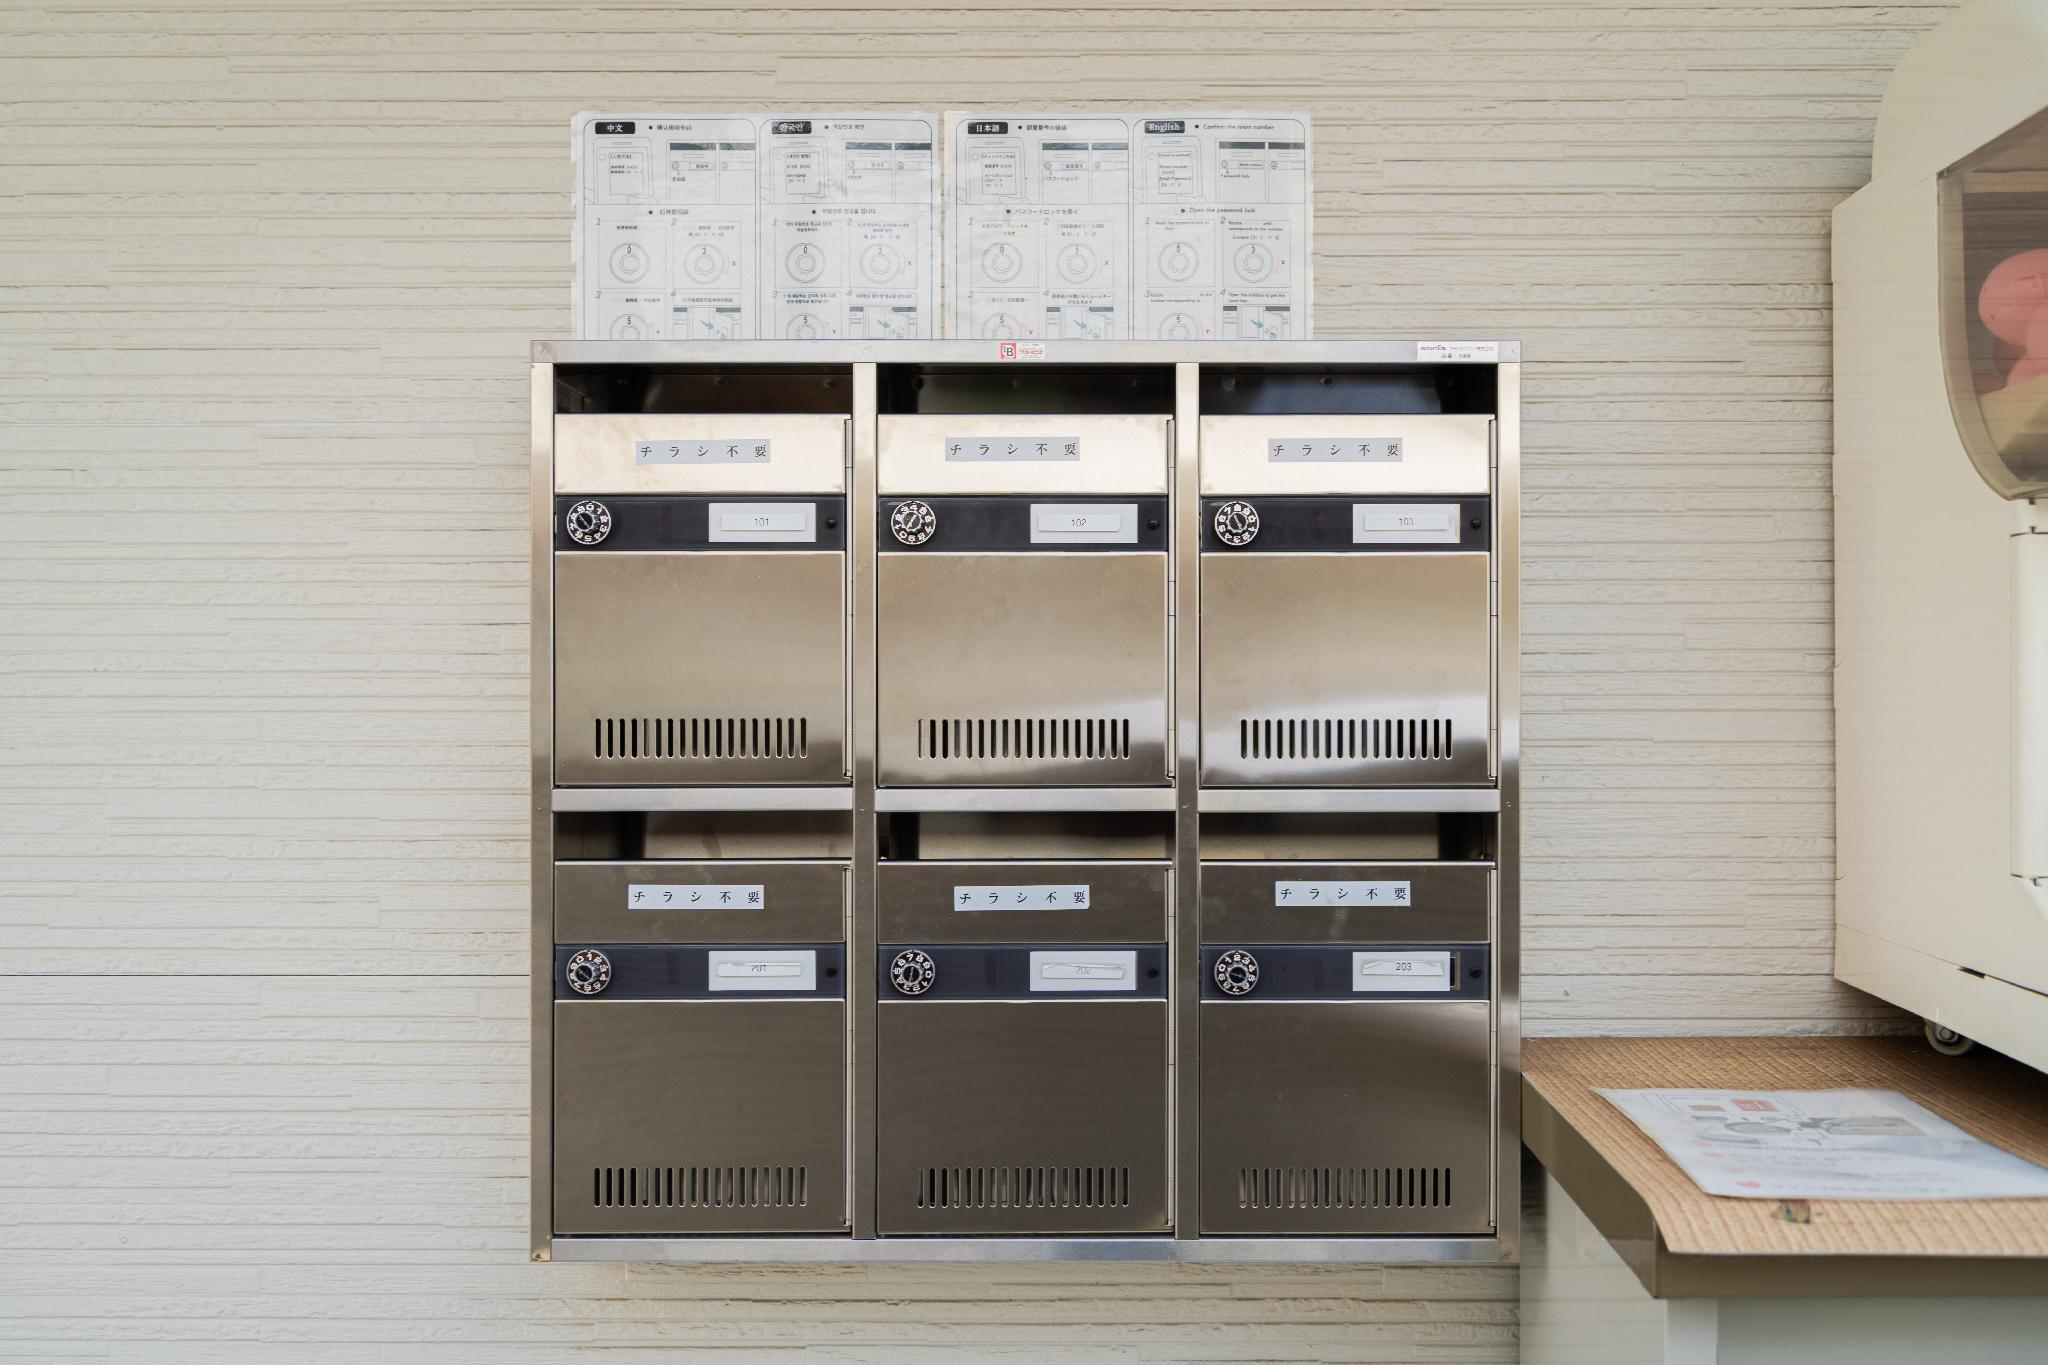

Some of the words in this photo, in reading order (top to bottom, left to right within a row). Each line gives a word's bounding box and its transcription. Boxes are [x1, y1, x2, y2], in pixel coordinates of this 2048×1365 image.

[607, 122, 623, 132] 中文
[976, 124, 1000, 133] 日本語
[1149, 122, 1181, 133] English
[641, 444, 767, 458] チラシ不要
[950, 443, 1077, 456] チラシ不要
[1273, 444, 1400, 457] チラシ不要
[754, 518, 769, 527] 101
[1071, 518, 1087, 527] 102
[1398, 518, 1414, 526] 103
[634, 890, 760, 904] チラシ不要
[960, 890, 1086, 904] チラシ不要
[1280, 887, 1407, 901] チラシ不要
[1396, 962, 1412, 971] 203
